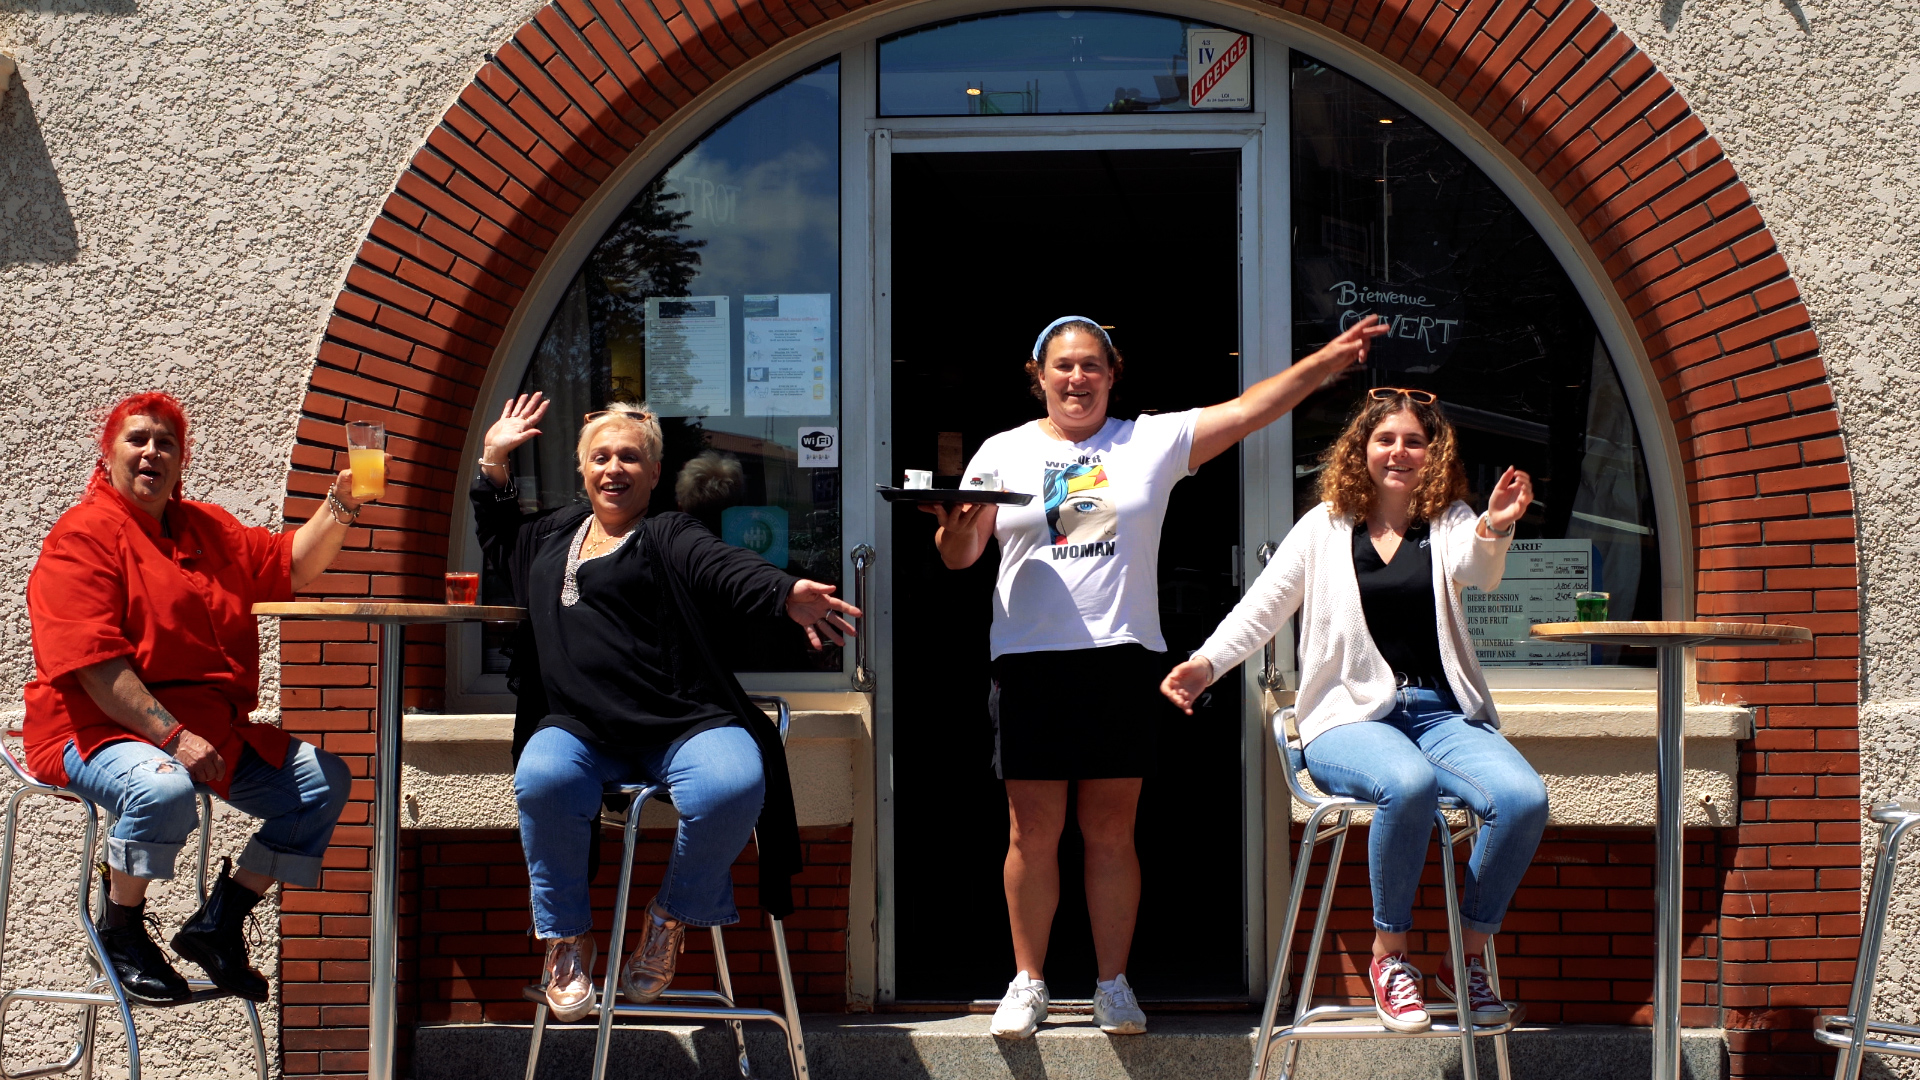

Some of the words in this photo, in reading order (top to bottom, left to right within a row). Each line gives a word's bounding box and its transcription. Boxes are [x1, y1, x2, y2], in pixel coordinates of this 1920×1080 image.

[1198, 48, 1215, 65] IV
[1194, 36, 1245, 103] LICENCE
[1329, 280, 1436, 307] Bienvenue
[1051, 541, 1116, 561] WOMAN
[1467, 594, 1487, 602] BIERE
[1487, 593, 1519, 602] PRESSION
[1467, 605, 1487, 613] BIERE
[1487, 604, 1523, 613] BOUTEILLE
[1467, 616, 1479, 625] JUS
[1480, 616, 1489, 624] DE
[1489, 616, 1509, 624] FRUIT
[1468, 627, 1485, 636] SODA
[1481, 638, 1515, 647] MINERALE
